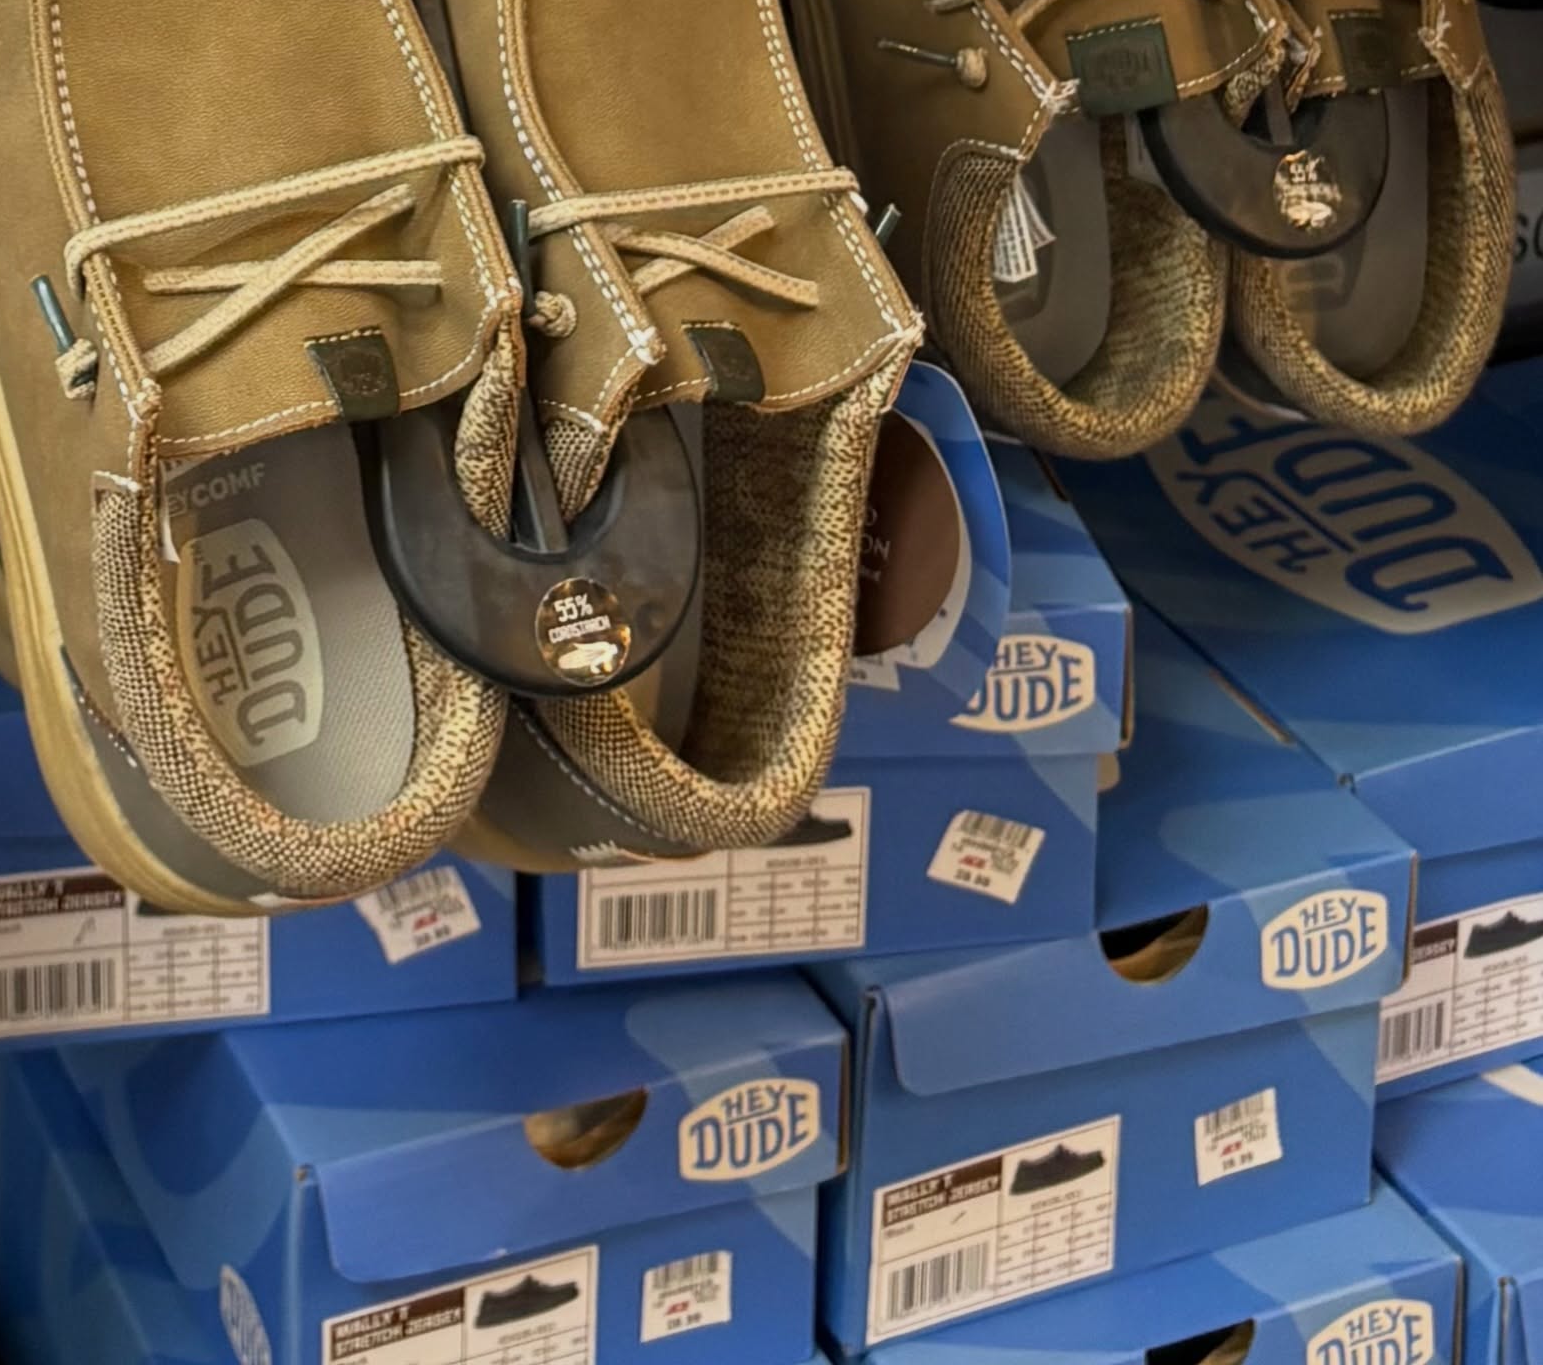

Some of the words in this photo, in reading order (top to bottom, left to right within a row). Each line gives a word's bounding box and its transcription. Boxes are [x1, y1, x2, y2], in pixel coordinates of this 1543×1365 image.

[1175, 469, 1353, 574] HEY
[201, 544, 307, 747] DUDE
[554, 593, 594, 623] 55%
[193, 605, 248, 706] HEY
[1270, 905, 1379, 980] DUDE
[1299, 896, 1359, 932] HEY
[689, 1091, 811, 1172] DUDE
[720, 1083, 791, 1122] HEY
[1345, 1305, 1405, 1340] HEY
